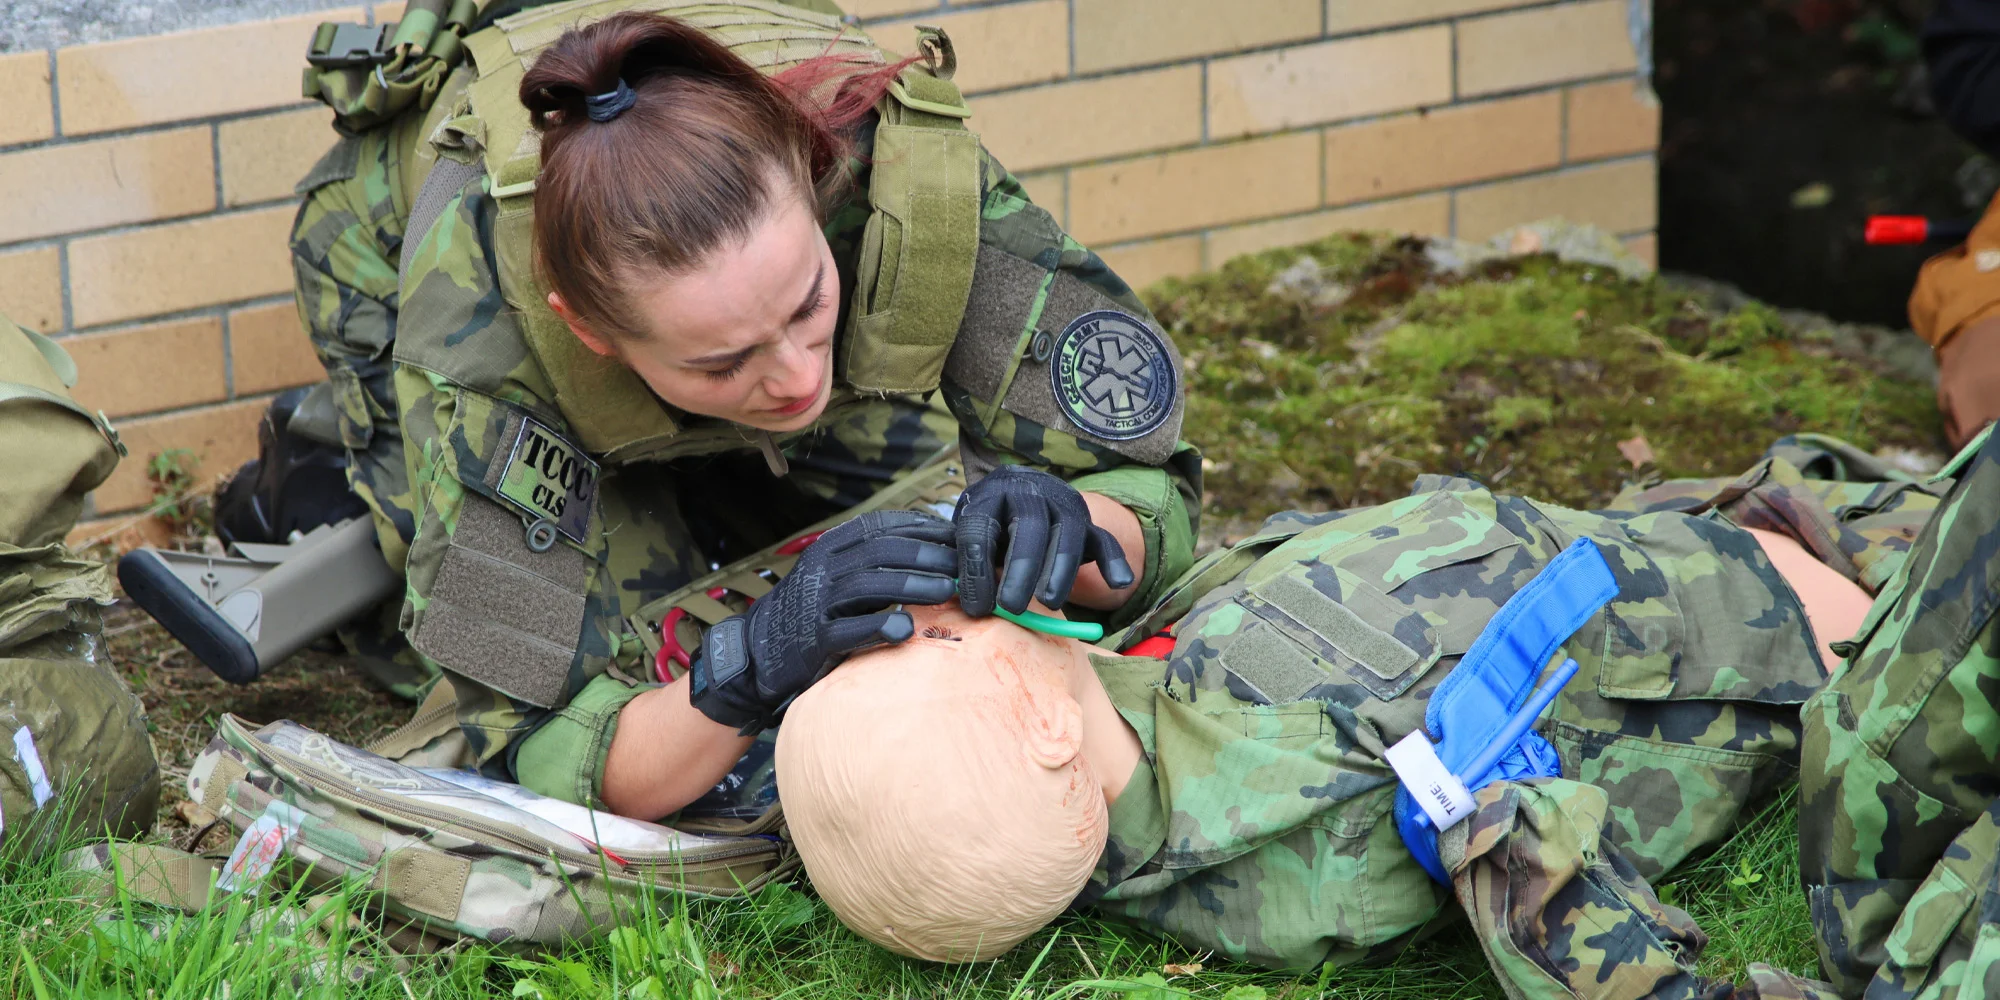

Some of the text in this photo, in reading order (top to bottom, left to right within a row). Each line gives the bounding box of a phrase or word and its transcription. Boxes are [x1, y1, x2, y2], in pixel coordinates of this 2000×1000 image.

[1132, 331, 1153, 350] CARE
[1060, 321, 1100, 404] CZECH ARMY
[1105, 418, 1144, 429] TACTICAL
[1143, 393, 1166, 421] COMBAT
[524, 430, 593, 501] TCCC
[532, 484, 567, 517] CLS
[1429, 781, 1456, 816] TIME:
